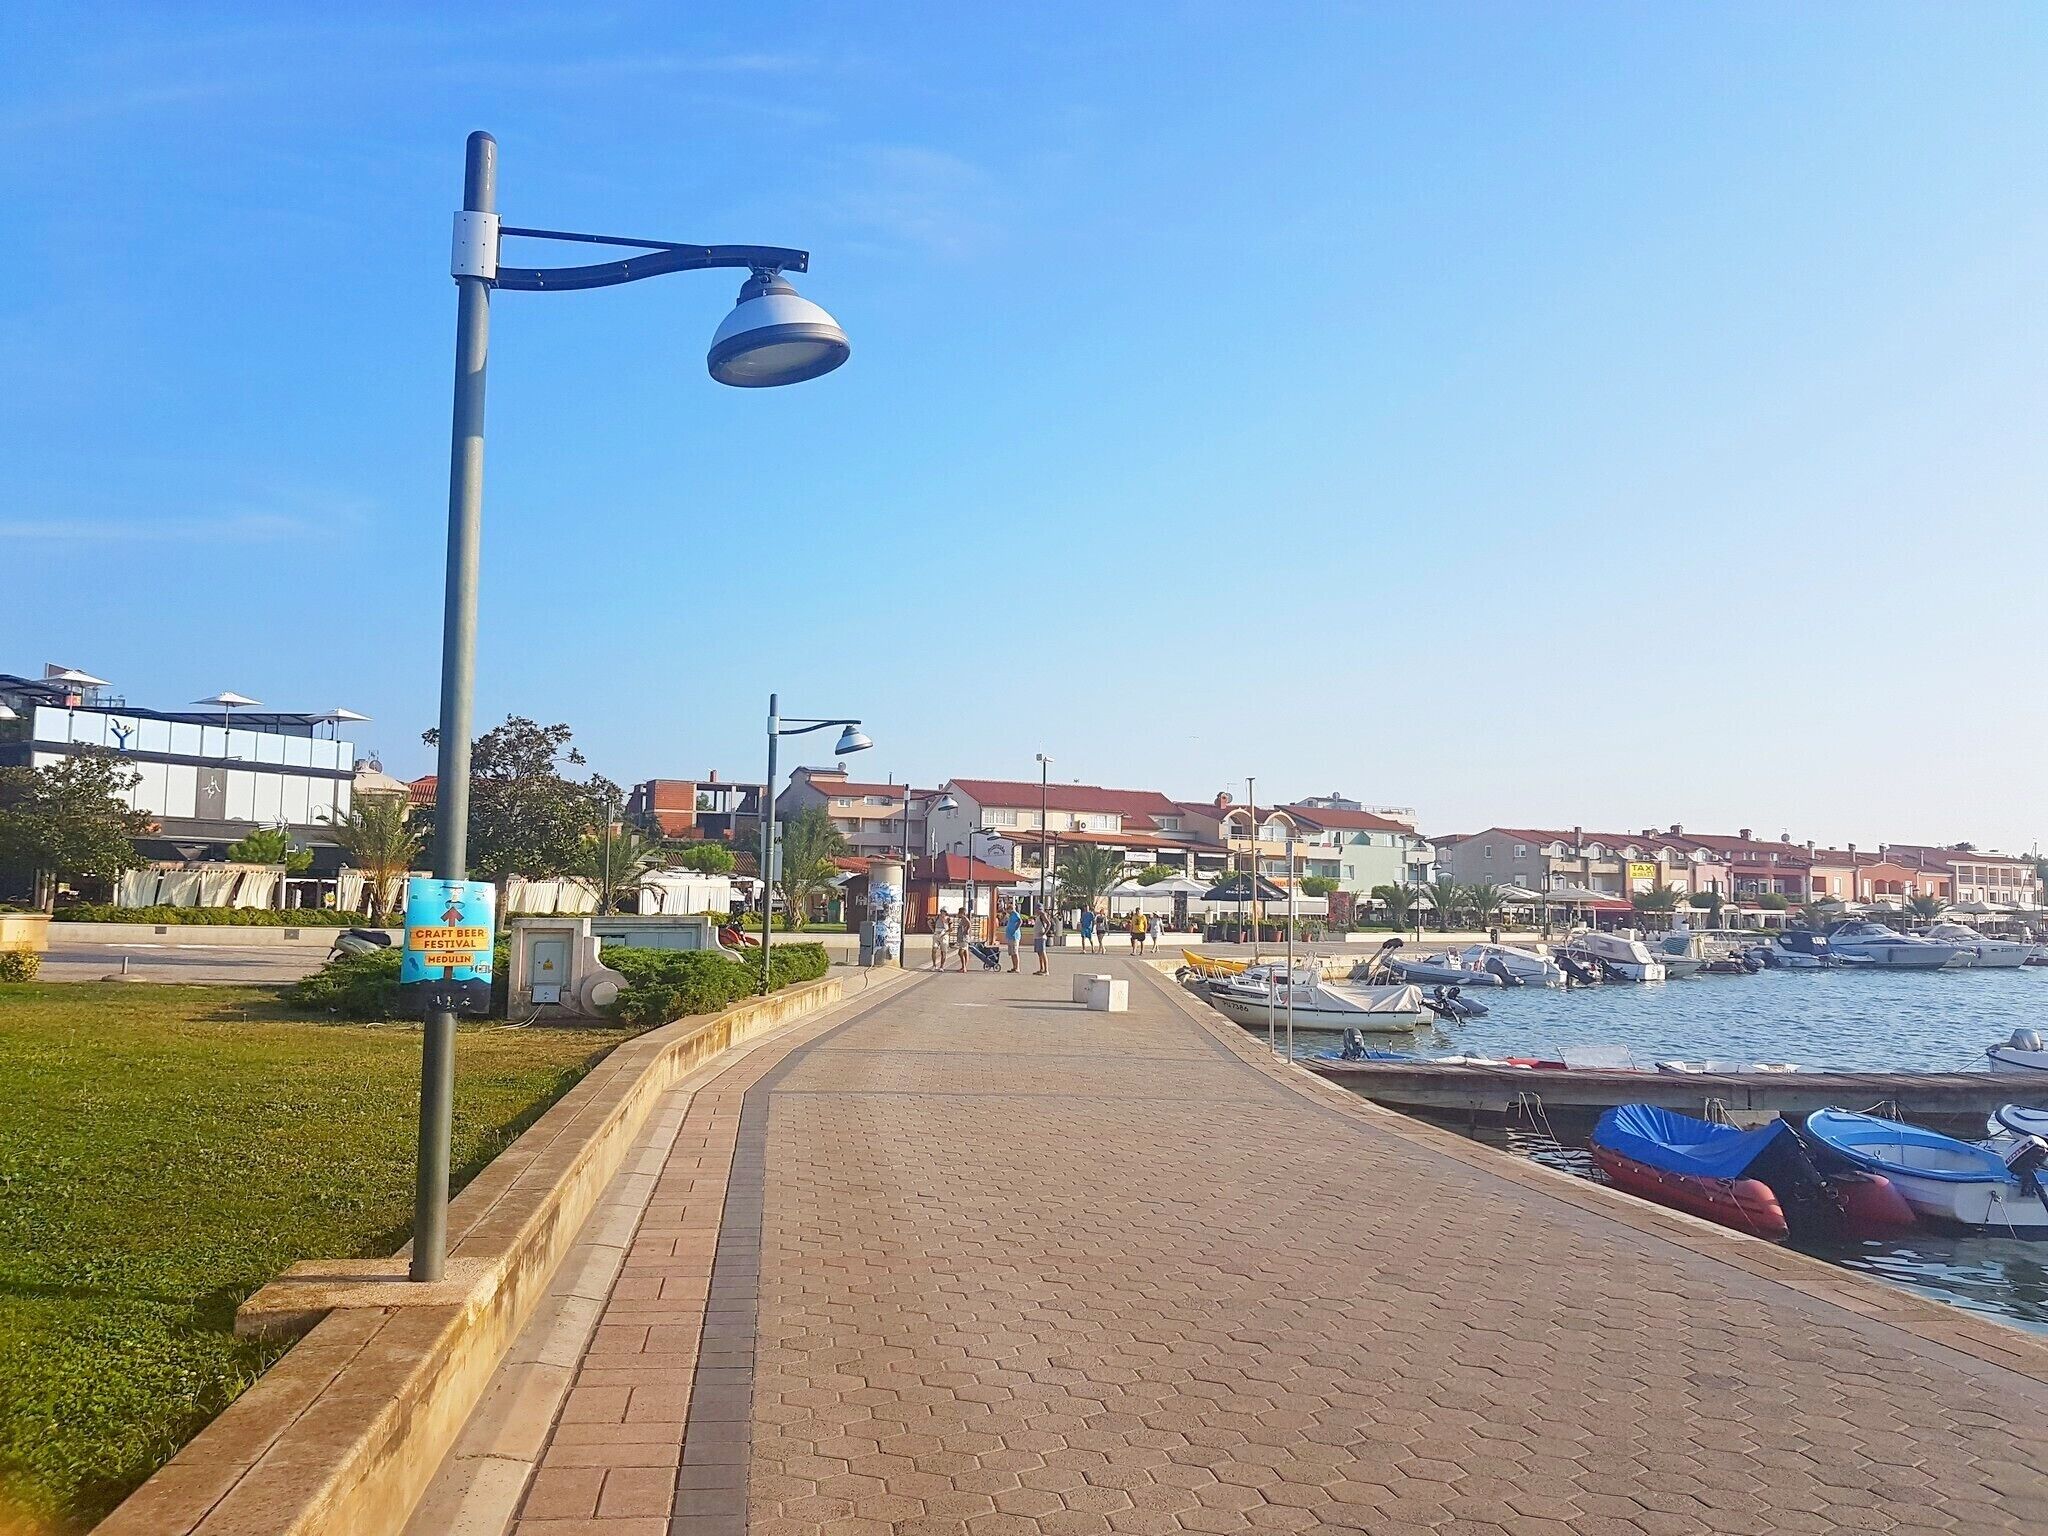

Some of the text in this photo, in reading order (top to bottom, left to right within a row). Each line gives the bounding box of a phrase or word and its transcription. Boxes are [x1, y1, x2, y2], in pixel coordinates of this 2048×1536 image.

[1631, 864, 1655, 872] TAXI
[416, 929, 485, 938] CRAFT BEER
[424, 939, 476, 949] FESTIVAL
